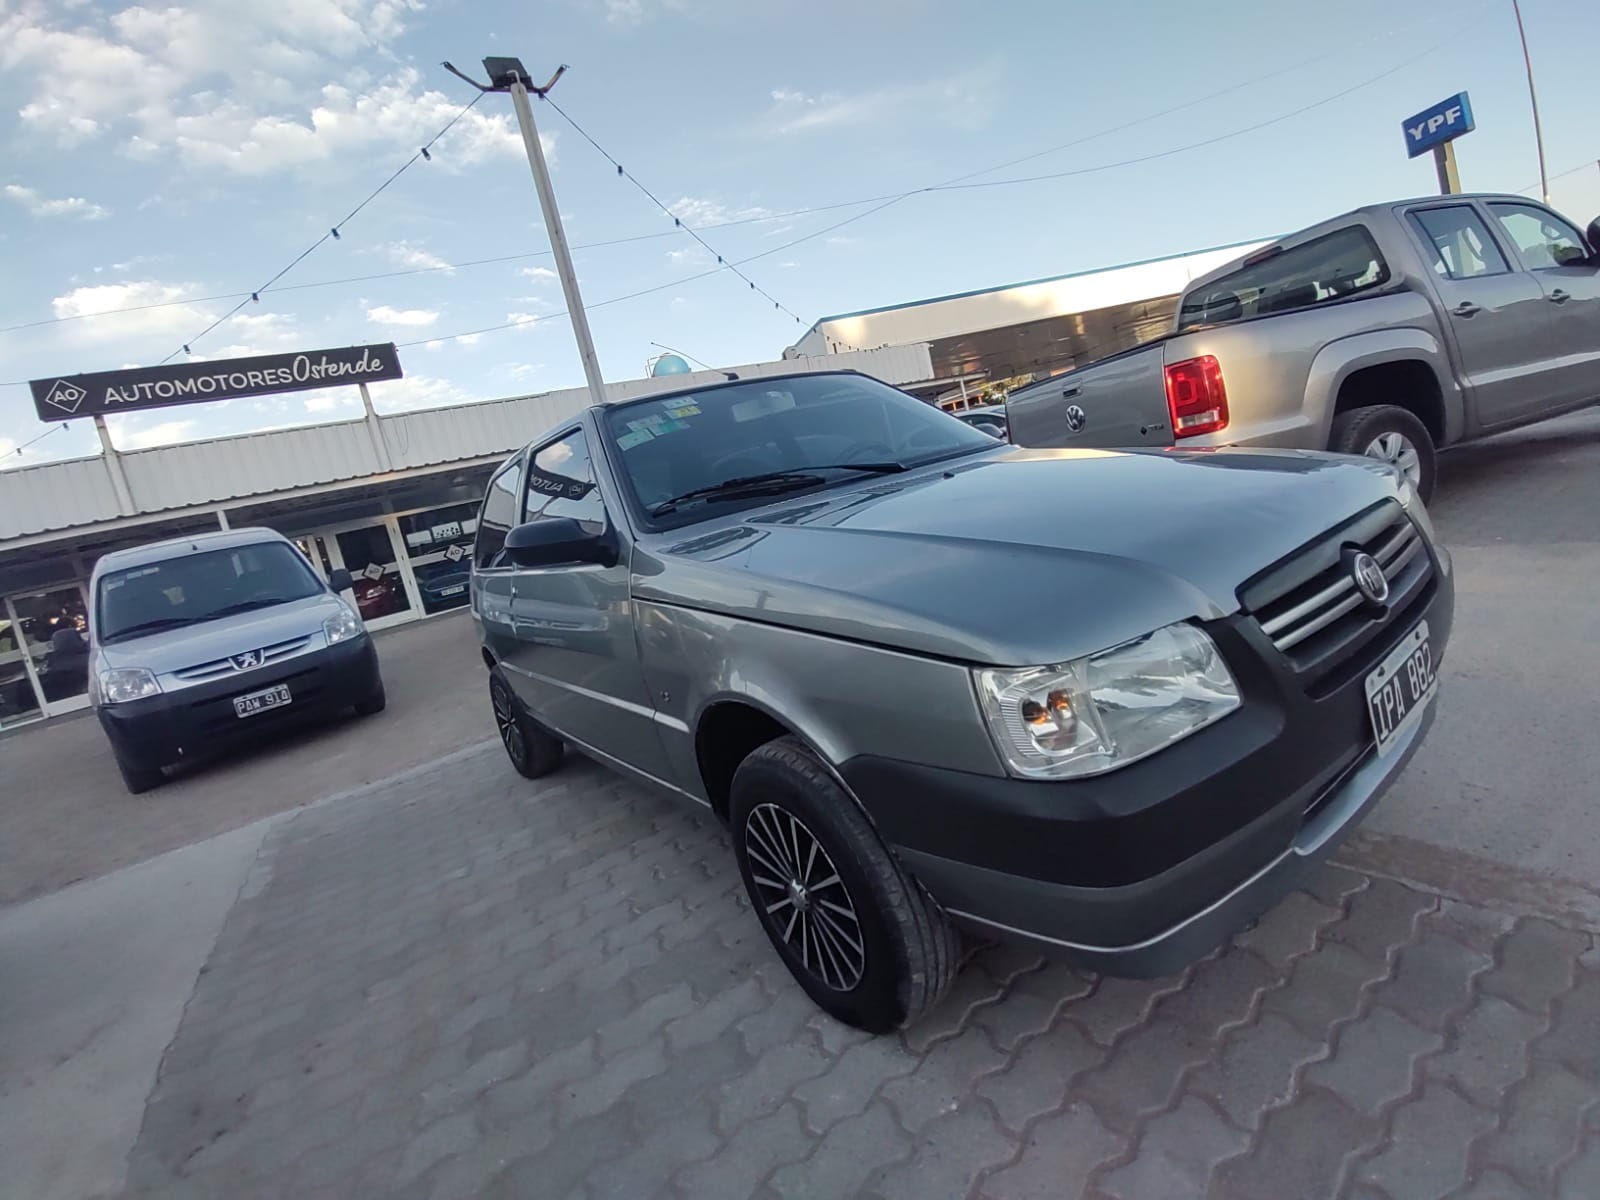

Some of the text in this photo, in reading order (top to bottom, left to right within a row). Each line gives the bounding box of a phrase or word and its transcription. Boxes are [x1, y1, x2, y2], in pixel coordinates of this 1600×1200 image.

[1408, 105, 1461, 140] YPF
[104, 349, 384, 405] AUTOMOTORES Ostende
[53, 388, 79, 403] AO
[236, 697, 261, 713] PAW
[1373, 641, 1435, 740] IPA 882
